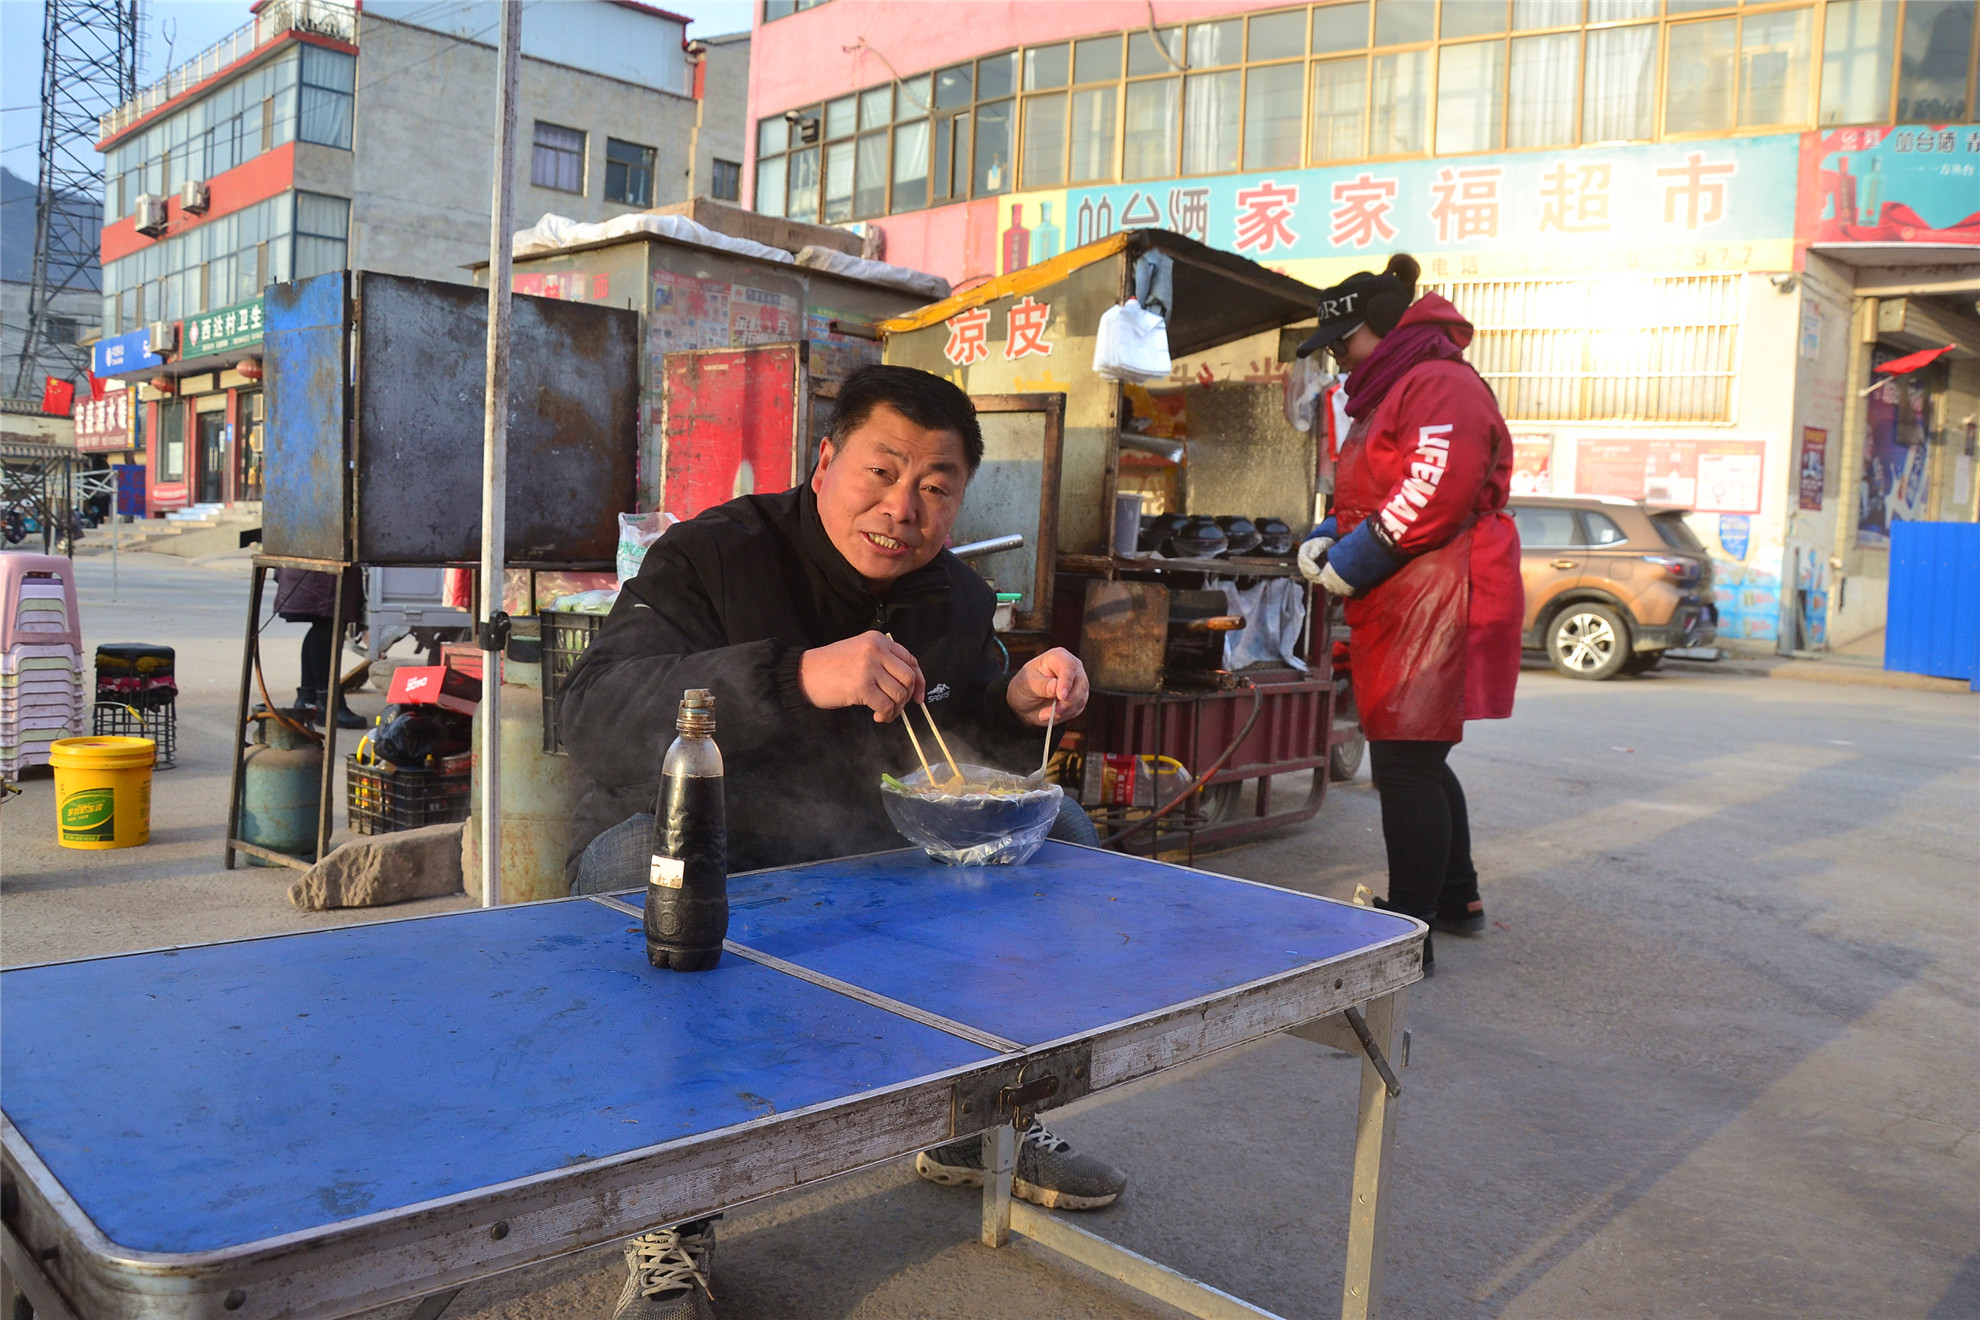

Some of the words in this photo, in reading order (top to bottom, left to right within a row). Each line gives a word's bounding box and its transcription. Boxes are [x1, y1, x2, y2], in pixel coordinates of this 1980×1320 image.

[1234, 152, 1736, 252] 家家福超市
[592, 272, 610, 299] 面
[944, 296, 1053, 366] 凉皮
